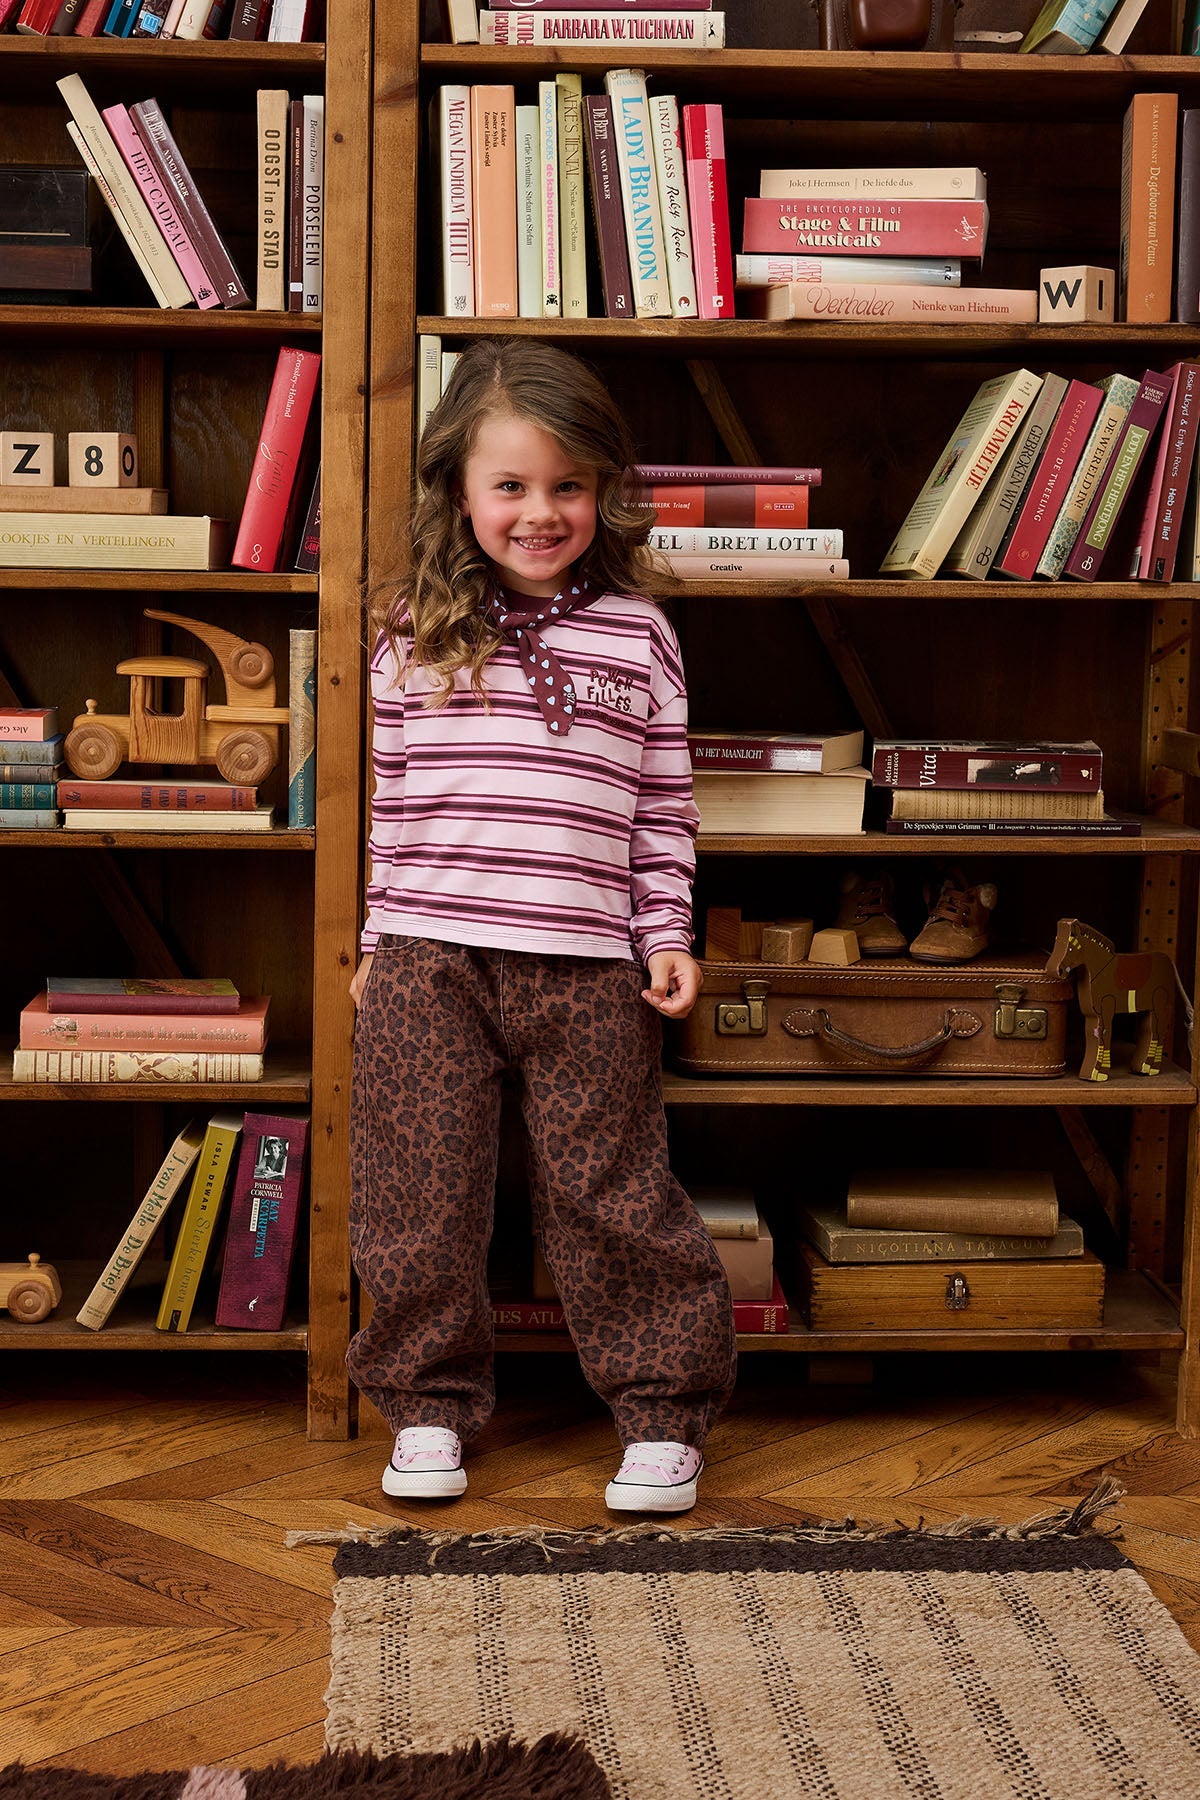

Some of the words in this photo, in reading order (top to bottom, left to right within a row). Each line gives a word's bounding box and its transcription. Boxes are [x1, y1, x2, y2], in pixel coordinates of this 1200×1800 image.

[494, 12, 509, 45] MARCH
[517, 12, 534, 46] FOLLY
[543, 18, 610, 40] BARBARA
[611, 19, 626, 39] W.
[627, 19, 694, 40] TUCHMAN
[544, 91, 552, 125] MONICA
[563, 88, 579, 133] AFKE'S
[657, 100, 670, 138] LINZI
[308, 118, 320, 147] Bettina
[448, 98, 465, 147] MEGAN
[621, 94, 647, 161] LADY
[263, 128, 281, 187] OOGST
[309, 149, 318, 174] Drion
[484, 151, 492, 167] strijd
[600, 149, 609, 172] NANCY
[662, 138, 676, 178] GLASS
[704, 127, 714, 175] VERLOREN
[163, 149, 178, 174] NANCY
[172, 173, 190, 199] BAKER
[449, 149, 466, 215] LINDHOLM
[525, 153, 533, 189] Evenhuis
[545, 163, 553, 178] de
[789, 180, 807, 188] Joke
[813, 179, 850, 187] Hermsen
[875, 179, 898, 187] liefde
[898, 179, 913, 187] dus
[1150, 167, 1160, 180] De
[263, 191, 274, 203] in
[601, 174, 611, 200] BAKER
[707, 176, 715, 202] MAN
[130, 150, 154, 183] HET
[149, 186, 190, 254] CADEAU
[525, 191, 533, 216] Stefan
[780, 205, 798, 213] THE
[806, 205, 882, 214] ENCYCLOPEDIA
[1147, 183, 1159, 228] geboorte
[263, 208, 274, 224] de
[305, 185, 320, 266] PORSELEIN
[628, 165, 659, 282] BRANDON
[778, 216, 832, 232] Stage
[837, 217, 852, 231] &
[858, 217, 901, 233] Film
[446, 217, 470, 266] TILLU
[526, 224, 534, 246] Stefan
[709, 222, 717, 249] Alfred
[796, 232, 882, 248] Musicals
[263, 230, 280, 270] STAD
[1147, 242, 1158, 268] Venus
[806, 286, 896, 317] Verhalen
[910, 300, 947, 313] Nienke
[948, 303, 966, 313] van
[967, 301, 1010, 315] Hichtum
[1043, 278, 1083, 309] W
[1097, 279, 1104, 311] I
[283, 352, 305, 418] Crossley-Holland
[1186, 370, 1196, 391] Josie
[1069, 400, 1086, 425] Tessa
[1181, 393, 1193, 416] Lloyd
[1105, 417, 1117, 435] DE
[965, 399, 1024, 491] KRUIMELTJE
[1127, 430, 1144, 455] JODY
[1175, 428, 1187, 455] Emlyn
[12, 443, 41, 474] Z
[84, 445, 104, 477] 8
[1005, 423, 1044, 492] GEBROKEN
[1054, 456, 1064, 472] DE
[1081, 437, 1108, 489] WERELD
[1170, 456, 1183, 477] Rees
[1113, 465, 1130, 489] HET
[999, 487, 1019, 513] WIT
[1034, 469, 1059, 523] TWEELING
[1074, 491, 1087, 509] IN!
[1166, 487, 1177, 506] Heb
[1093, 484, 1121, 542] HERTEJONG
[1163, 509, 1173, 524] mij
[56, 533, 74, 545] EN
[82, 535, 176, 548] VERTELLINGEN
[708, 535, 760, 550] BRET
[767, 536, 817, 551] LOTT
[1161, 527, 1172, 541] lief
[710, 563, 742, 571] Creative
[590, 667, 633, 692] POWER
[587, 685, 632, 712] FILLES.
[10, 725, 29, 735] Alex
[695, 748, 704, 757] IN
[705, 748, 720, 757] HET
[721, 749, 763, 759] MAANLICHT
[891, 752, 899, 786] Mazzucco
[919, 753, 938, 787] Vita
[914, 823, 944, 831] Sprookjes
[164, 1152, 188, 1168] J.
[211, 1142, 223, 1167] ISLA
[156, 1167, 176, 1189] van
[254, 1182, 283, 1192] PATRICIA
[200, 1174, 216, 1212] DEWAR
[250, 1189, 284, 1199] CORNWELL
[136, 1191, 168, 1228] Melle
[268, 1200, 280, 1223] KAY
[190, 1217, 210, 1266] Sterke
[253, 1199, 270, 1259] SCARPETTA
[124, 1234, 144, 1254] De
[855, 1242, 956, 1255] NICOTIANA
[965, 1241, 1048, 1251] TABACUM
[101, 1252, 134, 1295] Brief
[528, 1311, 567, 1324] ATLA
